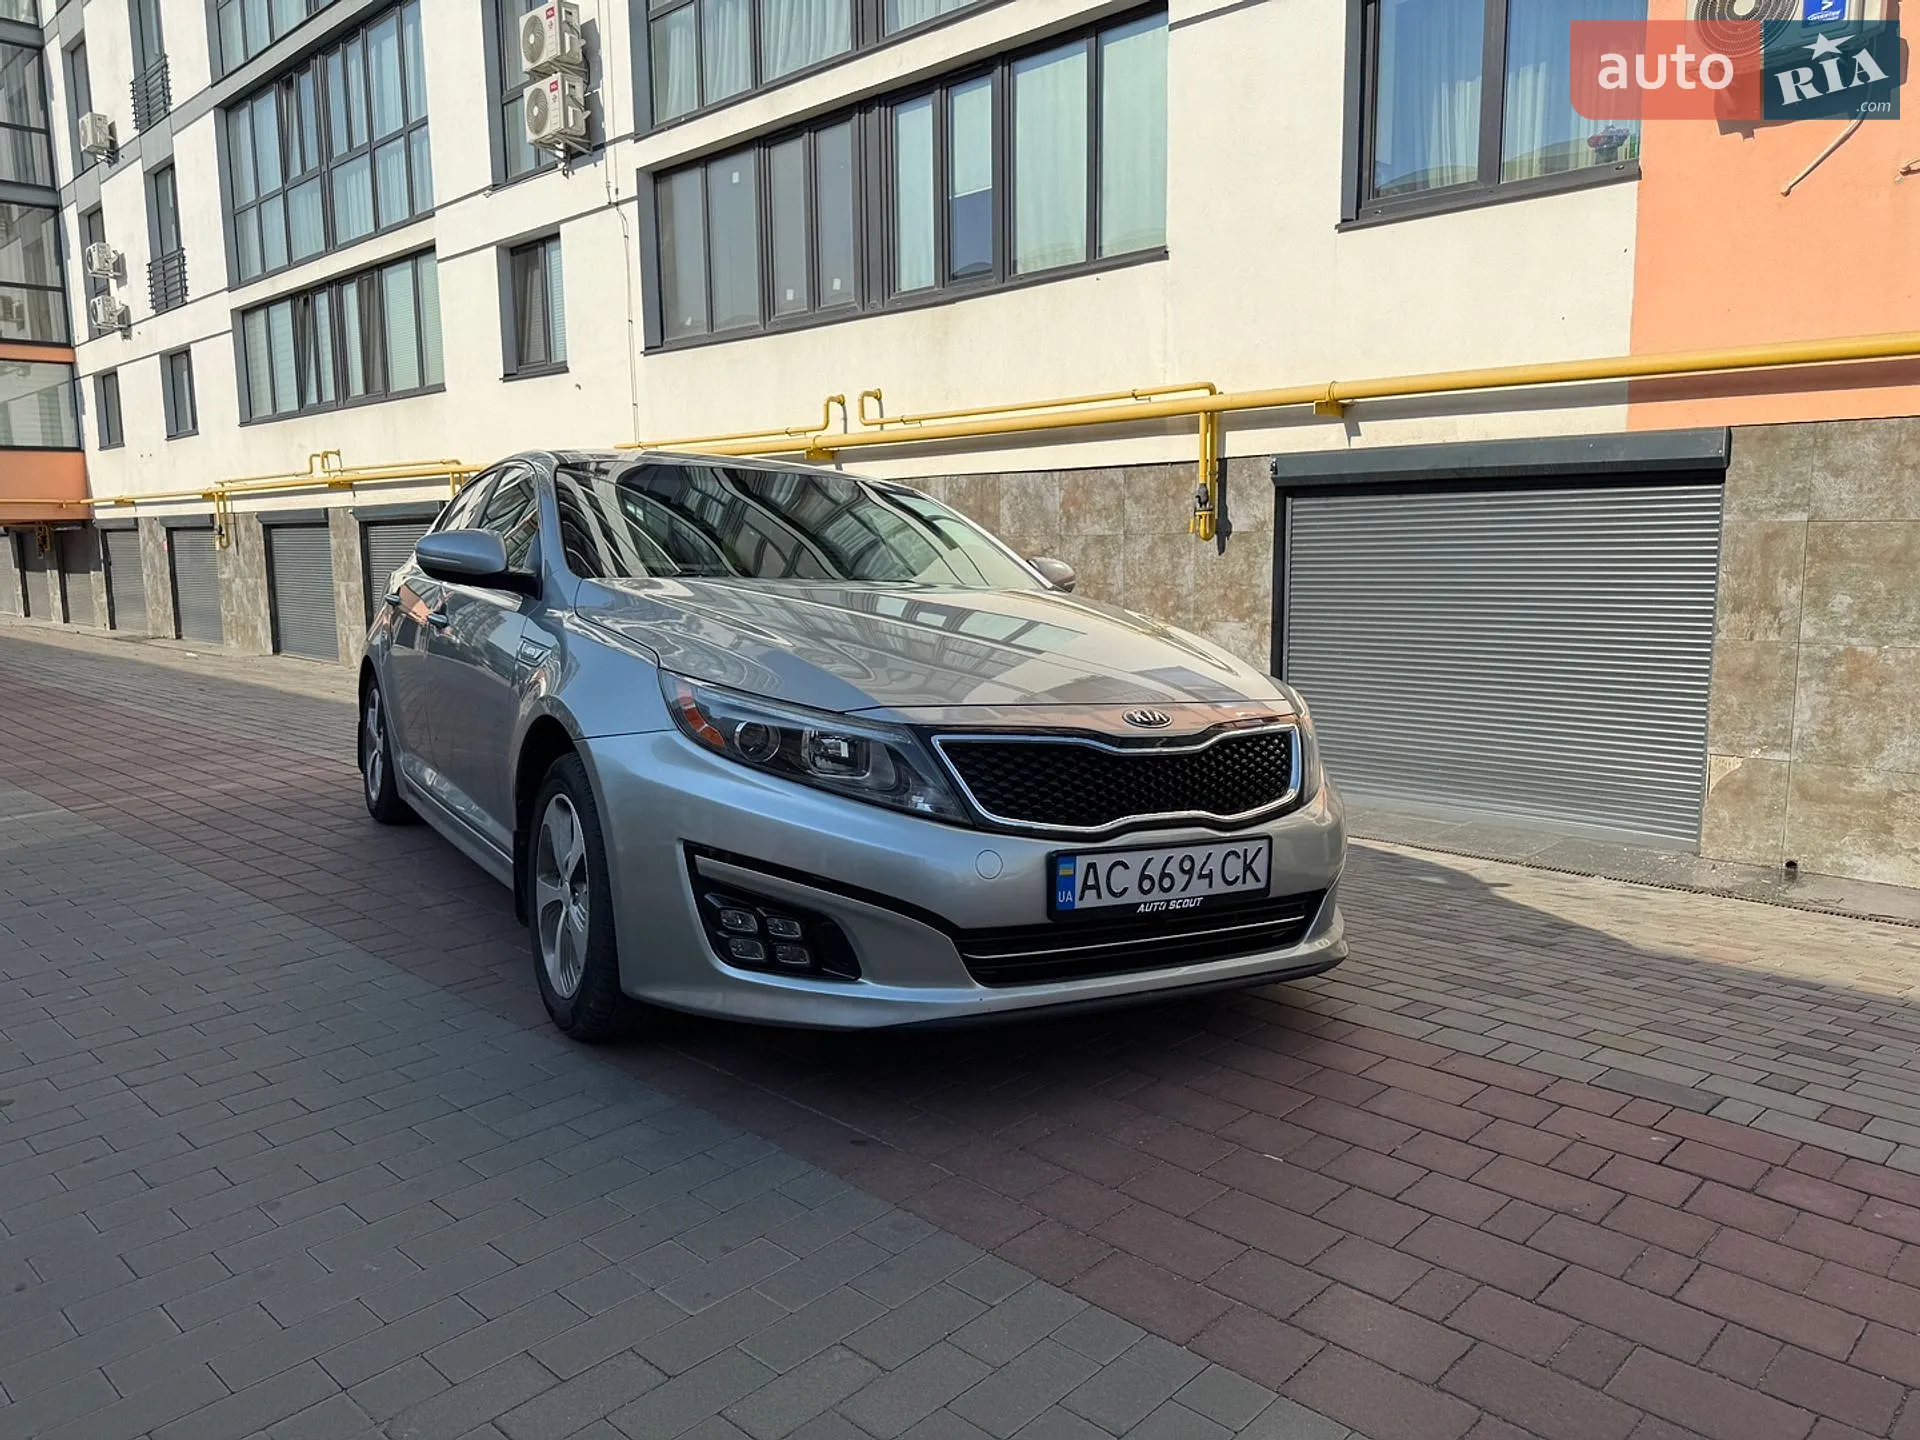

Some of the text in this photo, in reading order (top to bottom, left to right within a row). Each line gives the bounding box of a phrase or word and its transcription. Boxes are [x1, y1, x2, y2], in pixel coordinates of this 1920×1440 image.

[1131, 709, 1169, 722] KIA
[1058, 890, 1073, 903] UA
[1136, 897, 1204, 914] AUTO SCOUT
